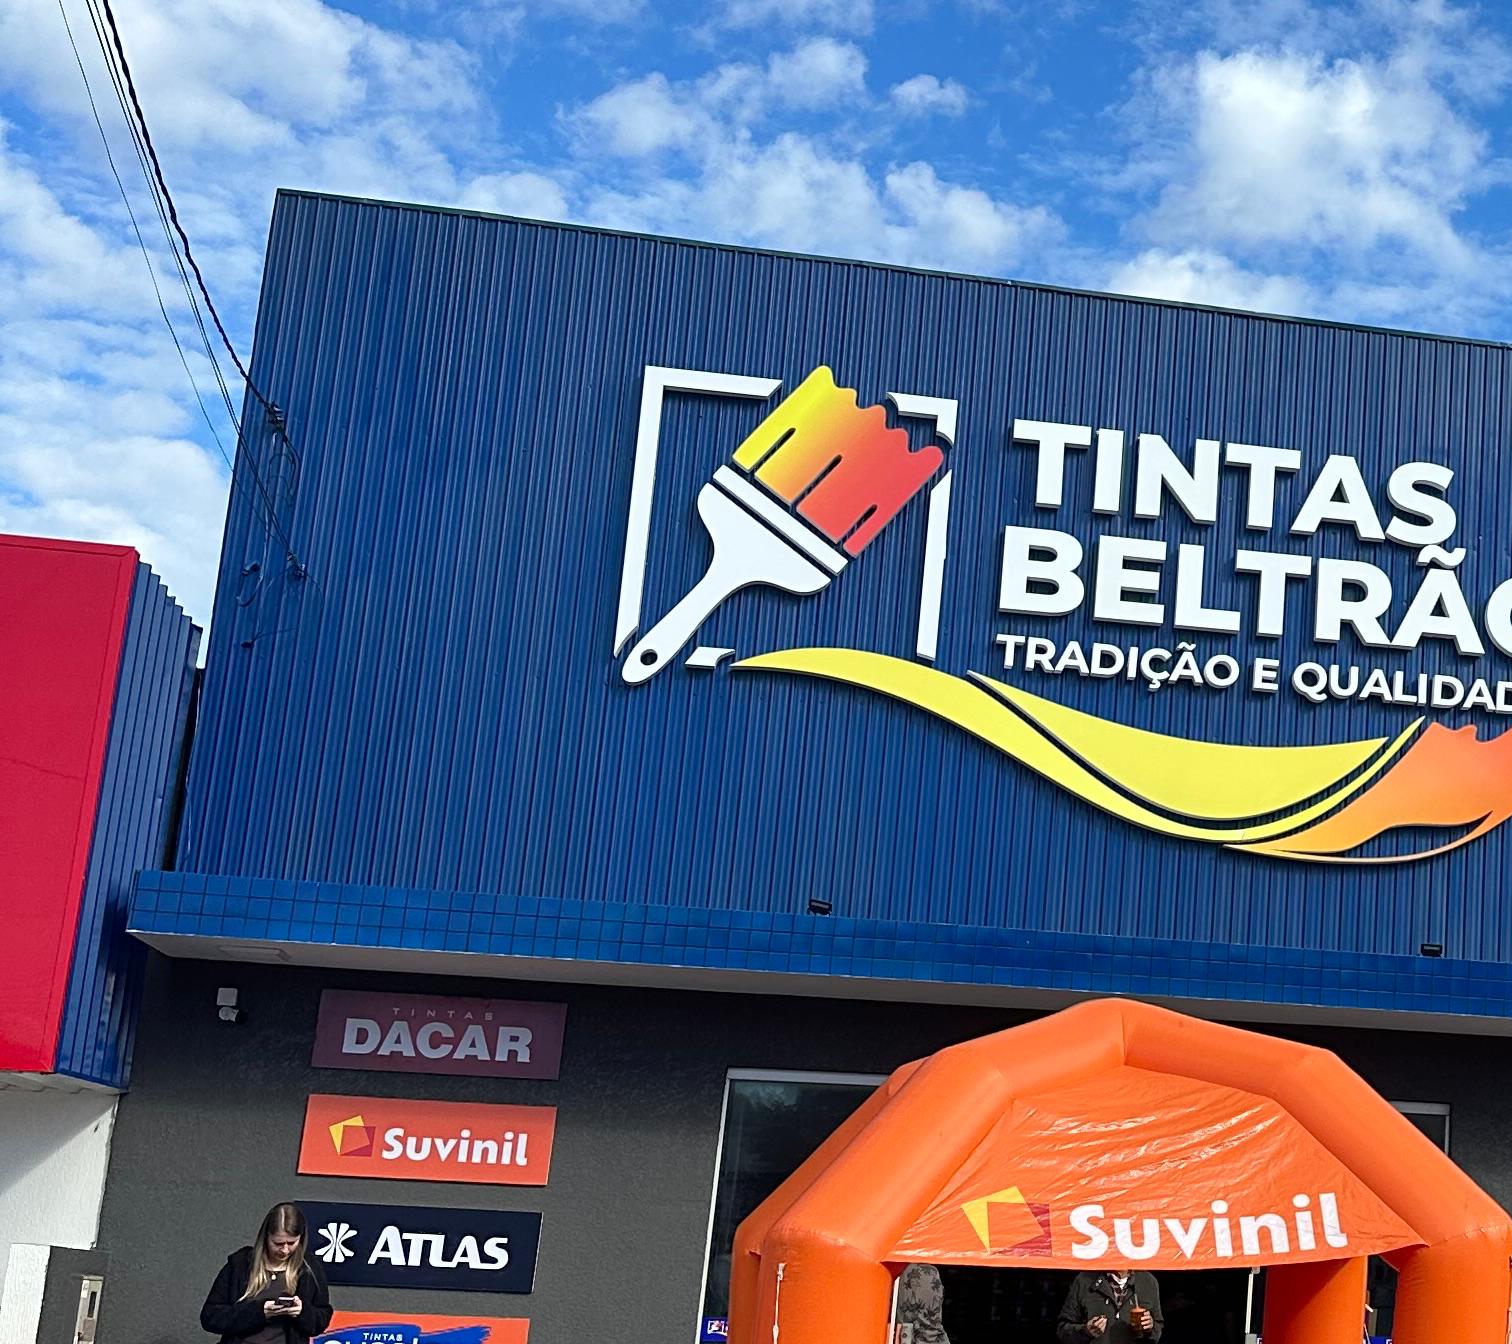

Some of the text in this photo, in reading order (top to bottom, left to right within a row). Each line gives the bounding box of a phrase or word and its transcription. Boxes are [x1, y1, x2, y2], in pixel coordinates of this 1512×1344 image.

[1011, 416, 1459, 551] TINTAS
[996, 632, 1241, 692] TRADIÇÃO
[1252, 658, 1280, 694] E
[392, 1007, 494, 1021] TINTAS
[341, 1017, 533, 1063] DACAR
[382, 1127, 528, 1166] Suvinil
[367, 1225, 509, 1270] ATLAS
[1068, 1192, 1349, 1260] Suvinil
[363, 1332, 403, 1342] TINTAS
